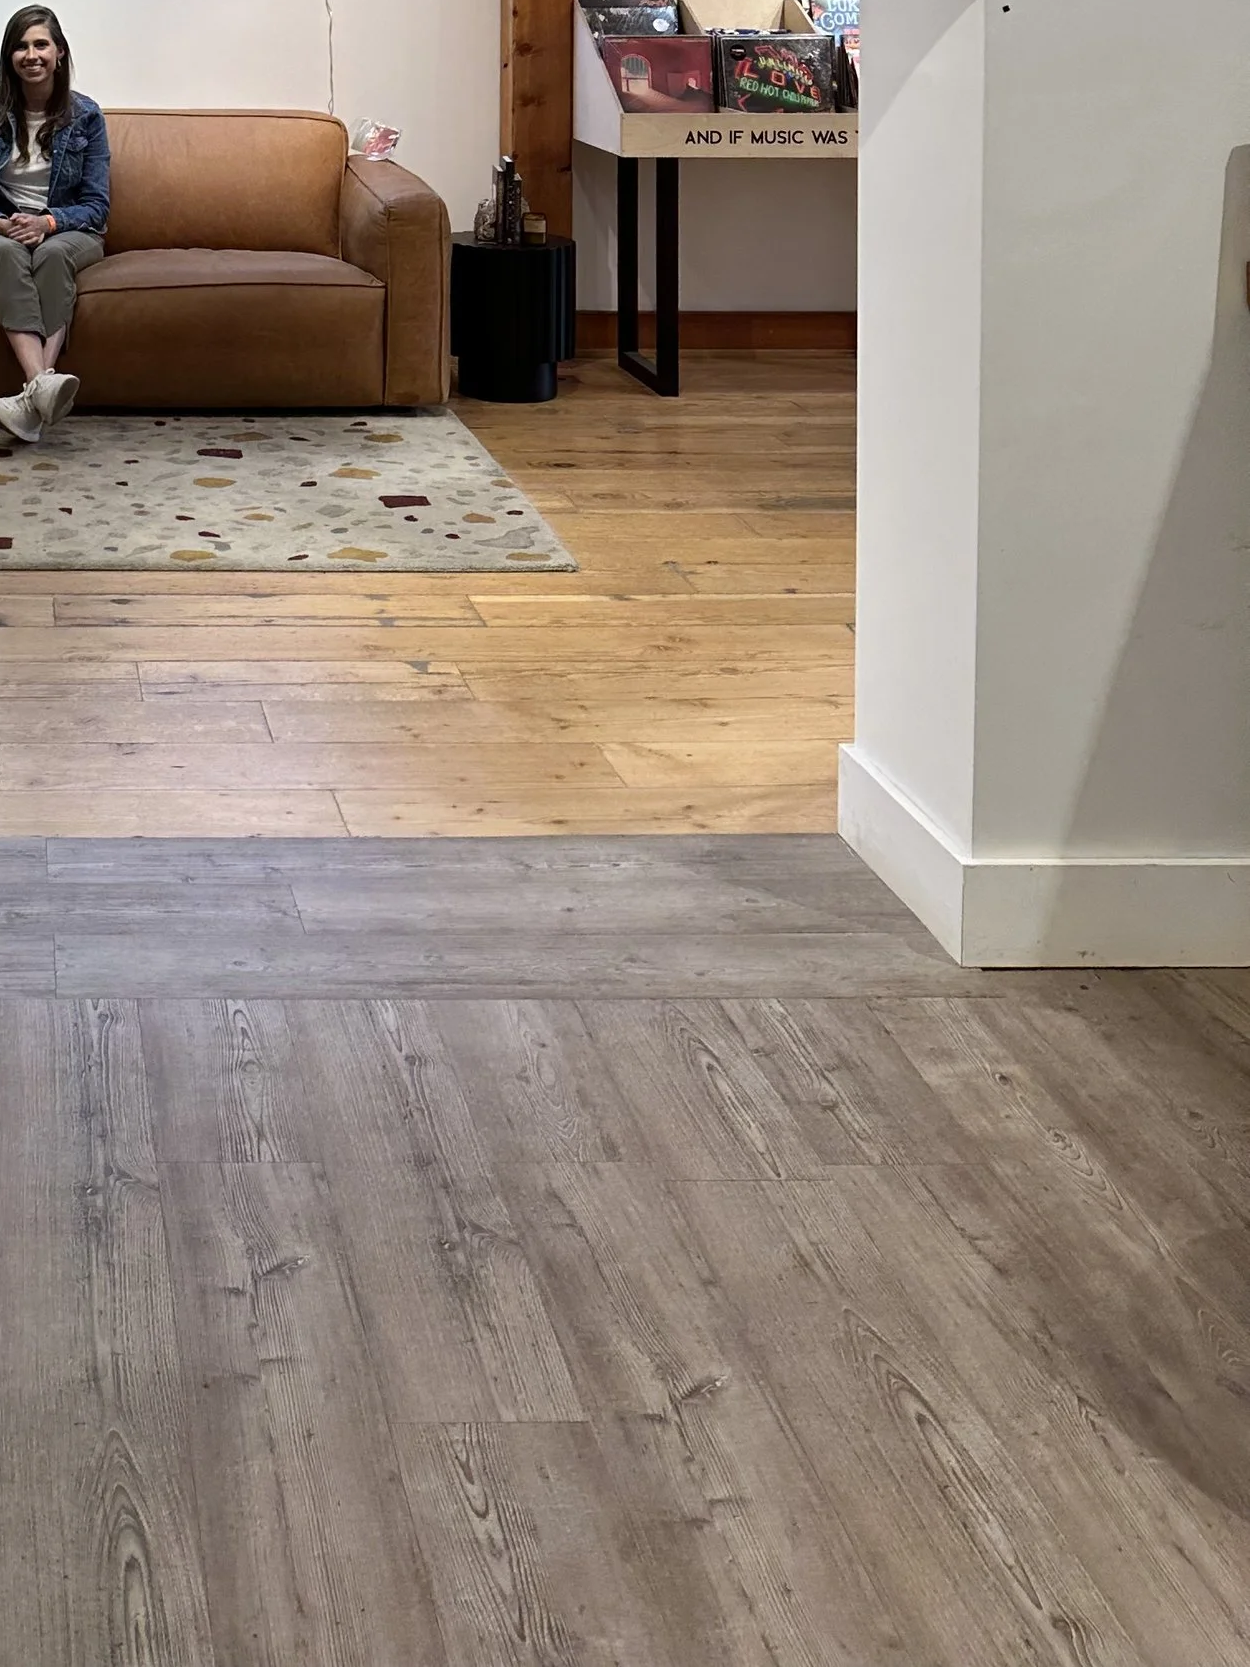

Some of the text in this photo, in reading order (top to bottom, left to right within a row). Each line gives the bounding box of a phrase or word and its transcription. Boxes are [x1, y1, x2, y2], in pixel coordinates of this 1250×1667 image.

[820, 12, 859, 30] COM
[739, 76, 759, 92] RED
[760, 82, 779, 98] HOT
[685, 130, 849, 145] AND IF MUSIC WAS
